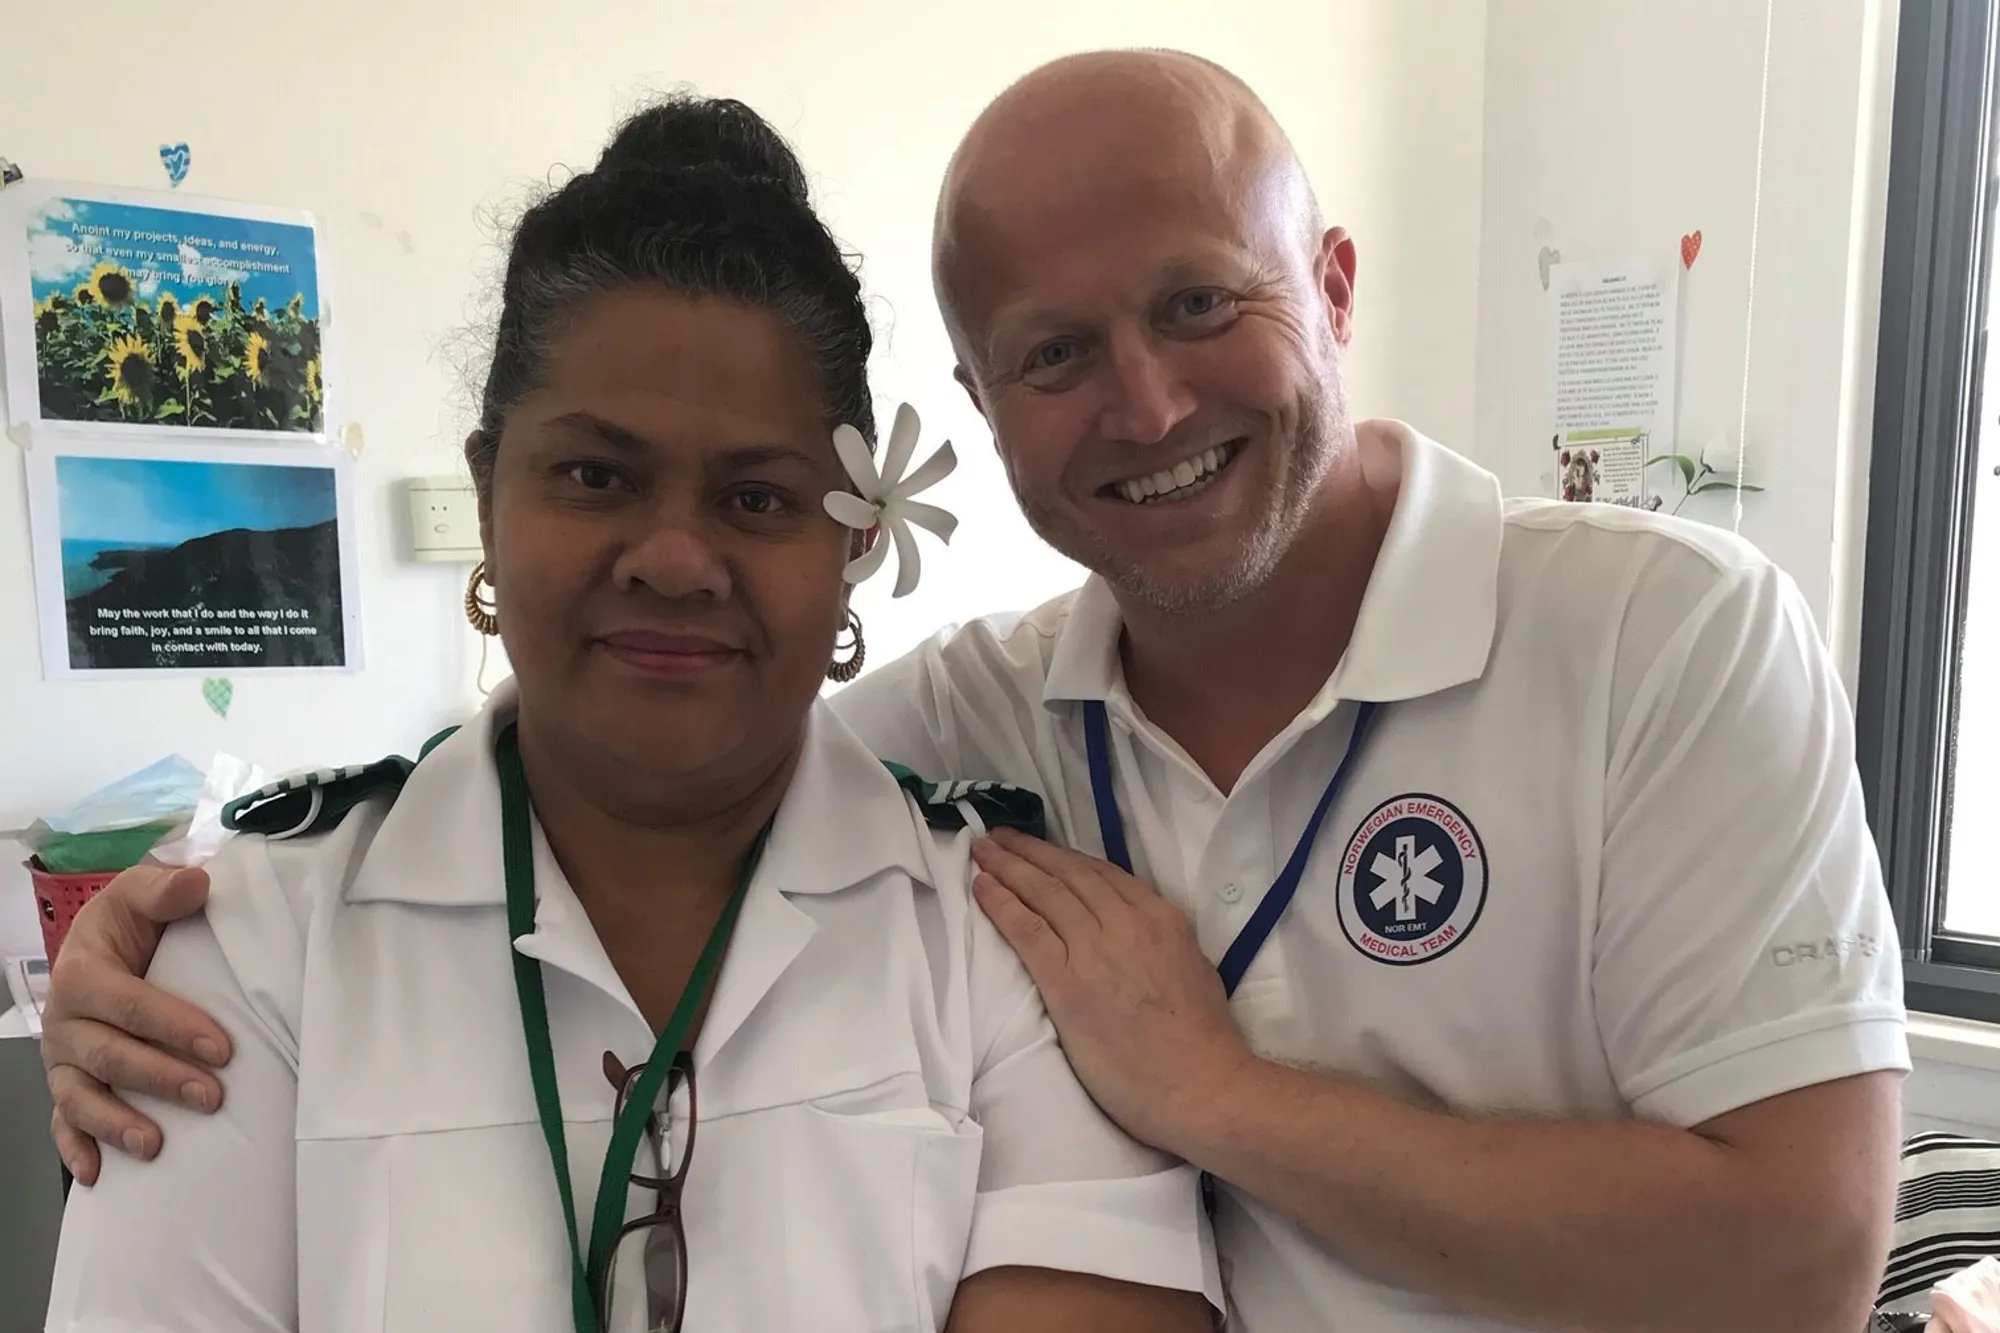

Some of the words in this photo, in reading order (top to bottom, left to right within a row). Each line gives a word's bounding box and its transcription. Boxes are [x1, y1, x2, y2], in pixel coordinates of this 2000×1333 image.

[72, 223, 109, 236] Anoint
[113, 229, 132, 239] my
[134, 231, 180, 244] projects,
[183, 235, 217, 249] ideas,
[219, 240, 239, 251] and
[105, 248, 133, 258] even
[136, 251, 155, 262] my
[204, 258, 291, 274] accomplishment
[151, 269, 181, 284] bring
[97, 607, 121, 621] May
[122, 608, 140, 619] the
[142, 608, 170, 619] work
[171, 608, 193, 619] that
[194, 609, 199, 619] I
[200, 608, 215, 619] do
[216, 608, 237, 619] and
[238, 608, 256, 619] the
[257, 610, 279, 621] way
[280, 608, 284, 619] I
[285, 608, 300, 619] do
[301, 608, 309, 619] it
[89, 625, 119, 639] bring
[120, 625, 149, 638] faith,
[150, 625, 171, 638] joy,
[172, 625, 193, 636] and
[195, 627, 202, 636] a
[204, 625, 232, 636] smile
[234, 625, 246, 636] to
[247, 625, 260, 636] all
[261, 625, 283, 636] that
[284, 625, 288, 636] I
[289, 626, 318, 636] come
[151, 642, 162, 652] in
[164, 642, 205, 653] contact
[206, 642, 229, 653] with
[230, 642, 263, 655] today.
[1344, 803, 1403, 875] NORWEGIAN
[1407, 802, 1477, 860] EMERGENCY
[1384, 924, 1406, 934] NOR
[1407, 922, 1427, 932] EMT
[1359, 933, 1418, 957] MEDICAL
[1420, 924, 1459, 953] TEAM
